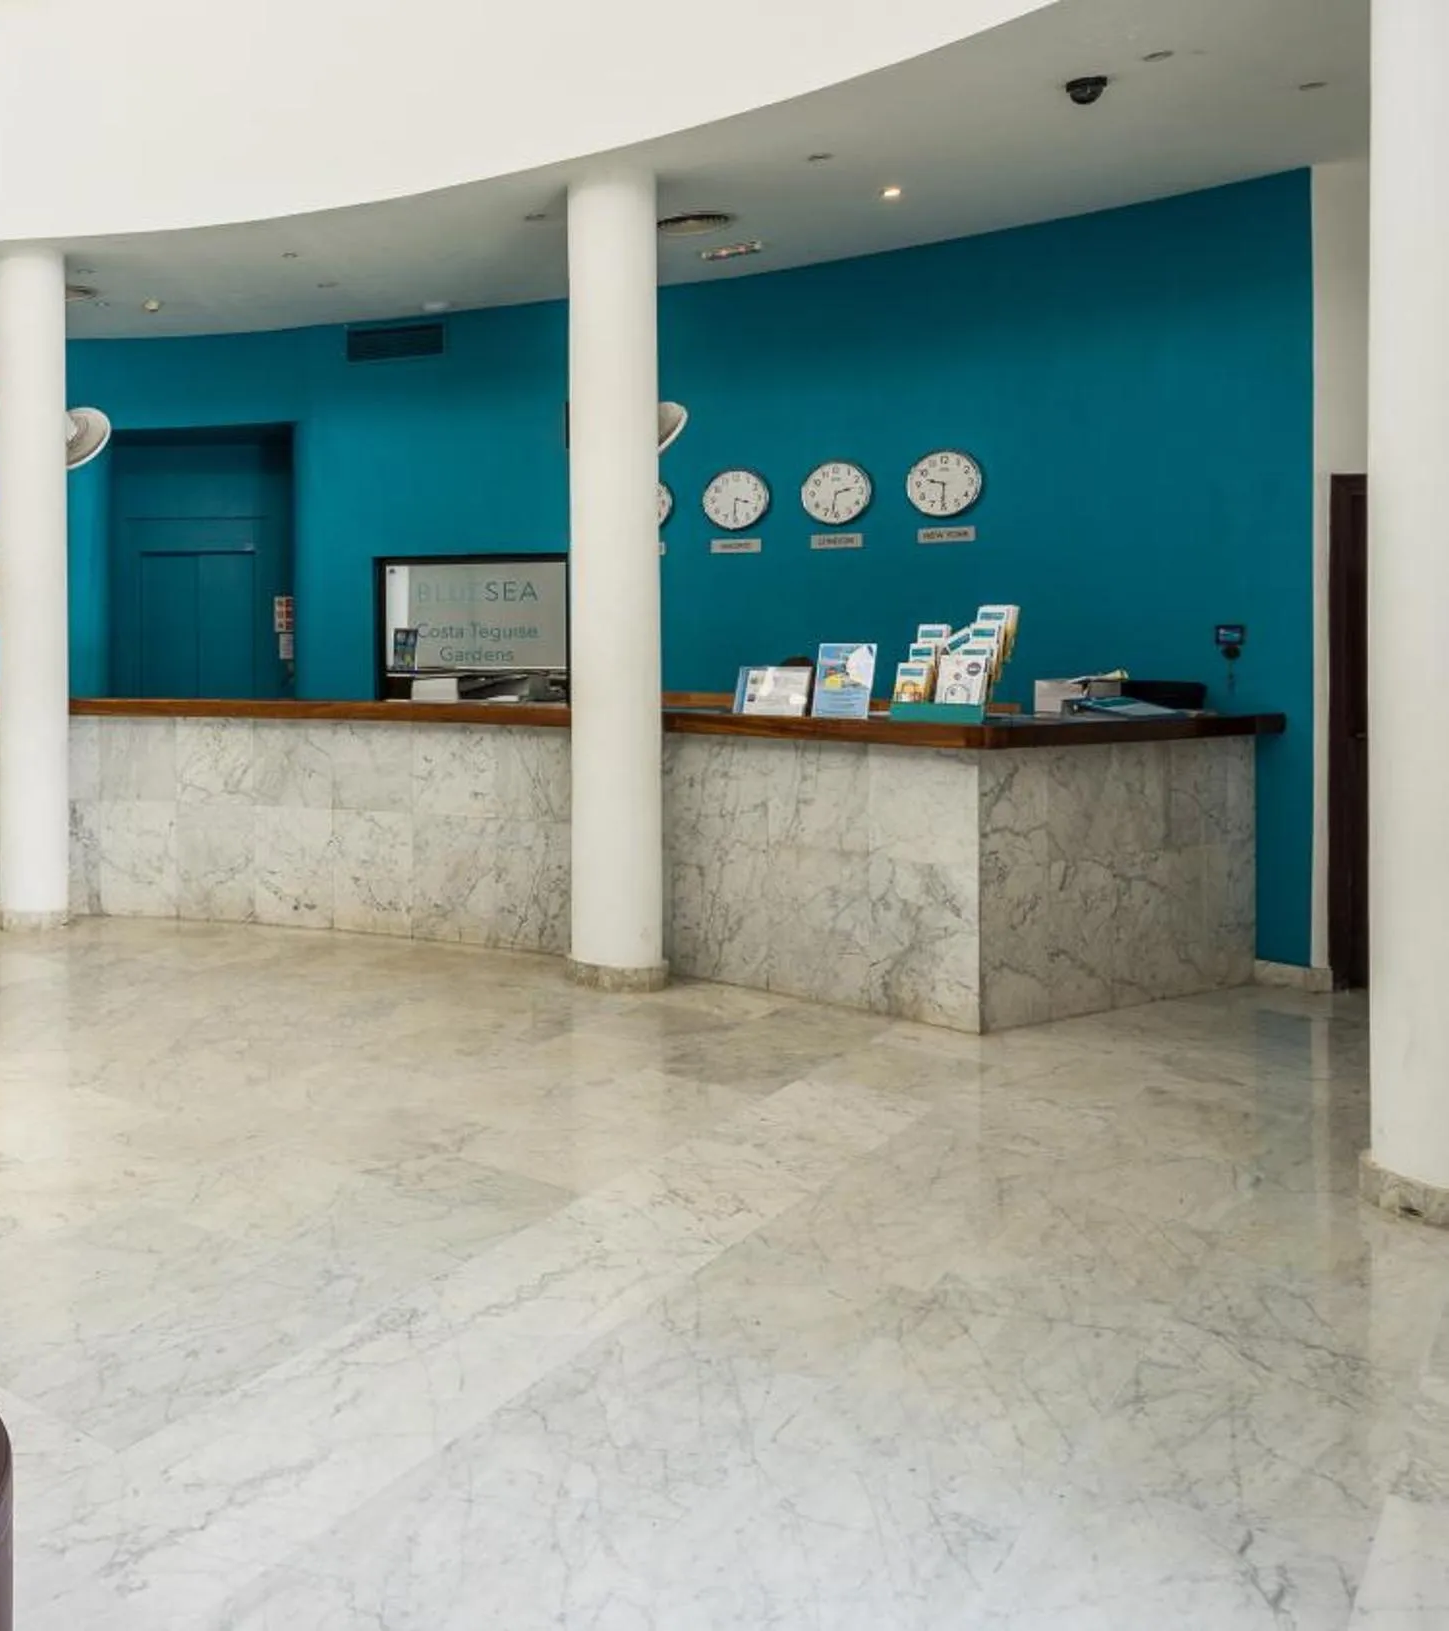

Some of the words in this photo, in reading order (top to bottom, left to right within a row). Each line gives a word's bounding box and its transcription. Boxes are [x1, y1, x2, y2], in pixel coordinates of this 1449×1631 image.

[416, 622, 464, 639] Costa
[469, 621, 541, 642] Teguise
[439, 645, 515, 662] Gardens
